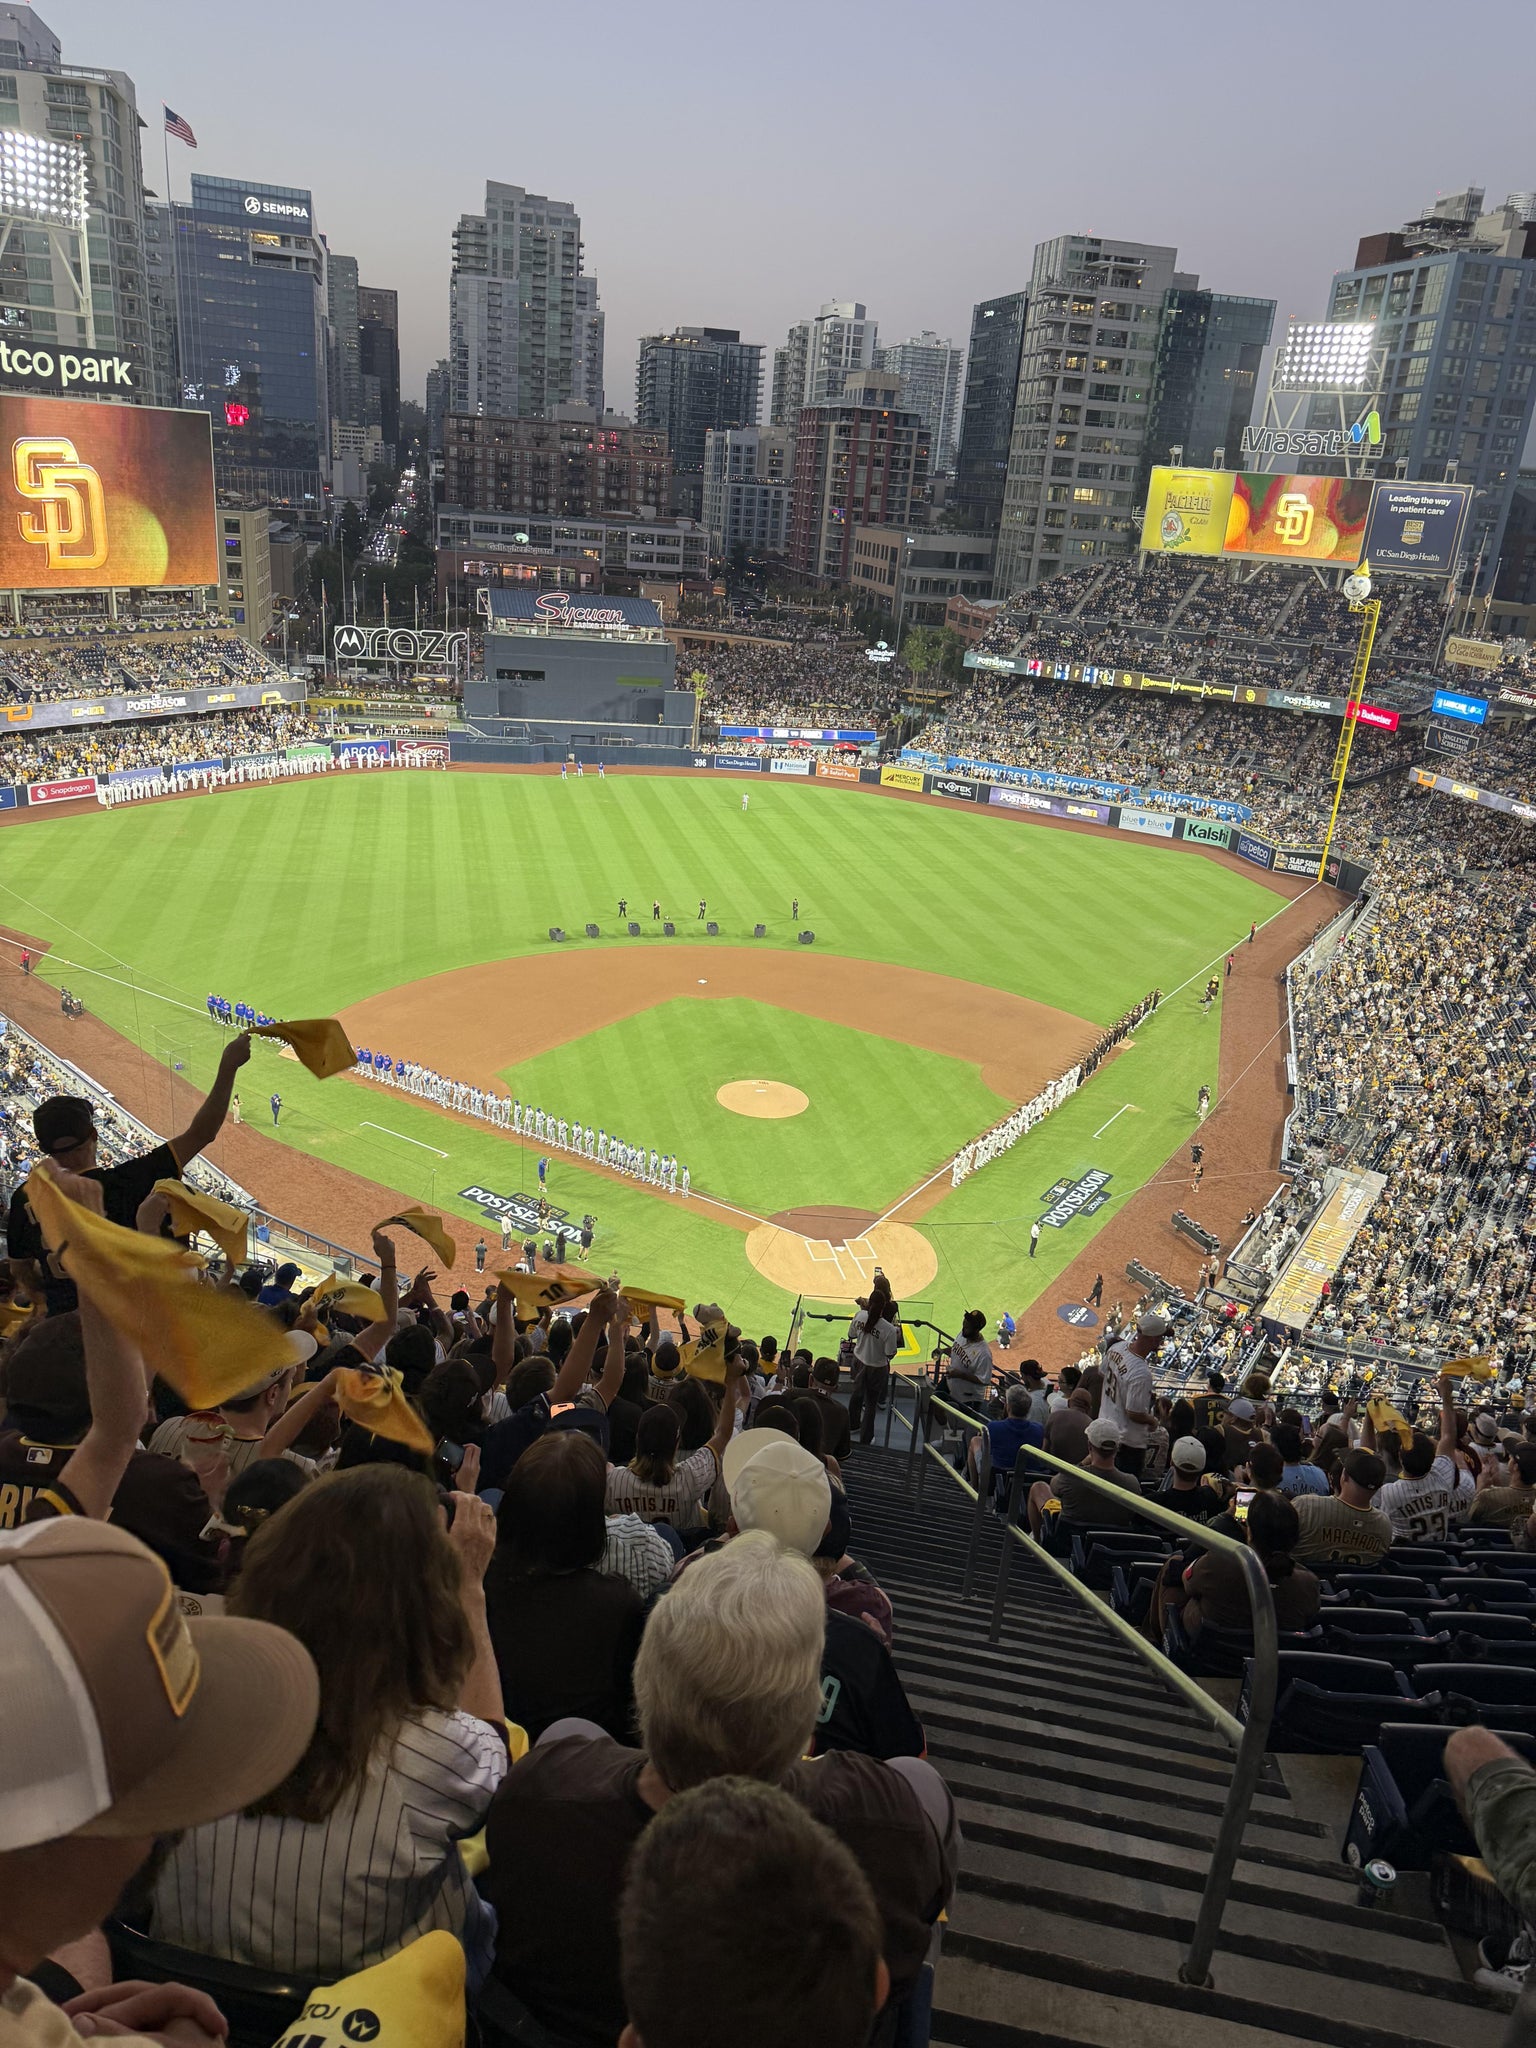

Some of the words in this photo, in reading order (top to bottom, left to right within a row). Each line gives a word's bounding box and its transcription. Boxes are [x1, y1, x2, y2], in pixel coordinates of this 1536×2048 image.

[262, 202, 308, 218] SEMPRA
[59, 353, 133, 386] park
[1245, 425, 1339, 457] Viasat
[1388, 493, 1419, 506] Leading
[1421, 495, 1434, 505] the
[1435, 497, 1451, 508] way
[1390, 504, 1397, 512] in
[1398, 505, 1427, 515] patient
[1428, 507, 1444, 516] care
[1376, 550, 1386, 558] UC
[1387, 551, 1399, 559] San
[1400, 552, 1418, 562] Diego
[1419, 553, 1440, 562] Health
[534, 592, 626, 627] Sycuan
[368, 626, 468, 663] razr
[865, 648, 896, 657] Gallagher
[976, 656, 1015, 669] POSTSEASON
[126, 696, 186, 712] POSTSEASON
[1282, 695, 1331, 709] POSTSEASON
[1360, 708, 1392, 726] Budweiser
[343, 745, 376, 759] ARCO
[694, 758, 707, 768] 396
[784, 761, 807, 769] National
[895, 772, 921, 782] MERCURY
[50, 782, 91, 795] Snapdragon
[999, 793, 1051, 810] POSTSEASON
[1121, 813, 1138, 824] blue
[1147, 818, 1165, 828] blue
[1187, 823, 1229, 844] Kalshi
[1247, 840, 1269, 861] petco
[1287, 863, 1306, 873] CHEESE
[1289, 857, 1304, 867] SLAP
[1042, 1170, 1110, 1227] POSTSEASON
[1043, 1193, 1055, 1202] 20
[615, 1496, 657, 1512] TATIS
[659, 1498, 680, 1512] JR.
[1397, 1495, 1434, 1518] TATIS
[1409, 1512, 1445, 1541] 23
[1322, 1527, 1381, 1553] MACHADO
[1359, 1791, 1375, 1828] petco
[1358, 1805, 1372, 1836] park
